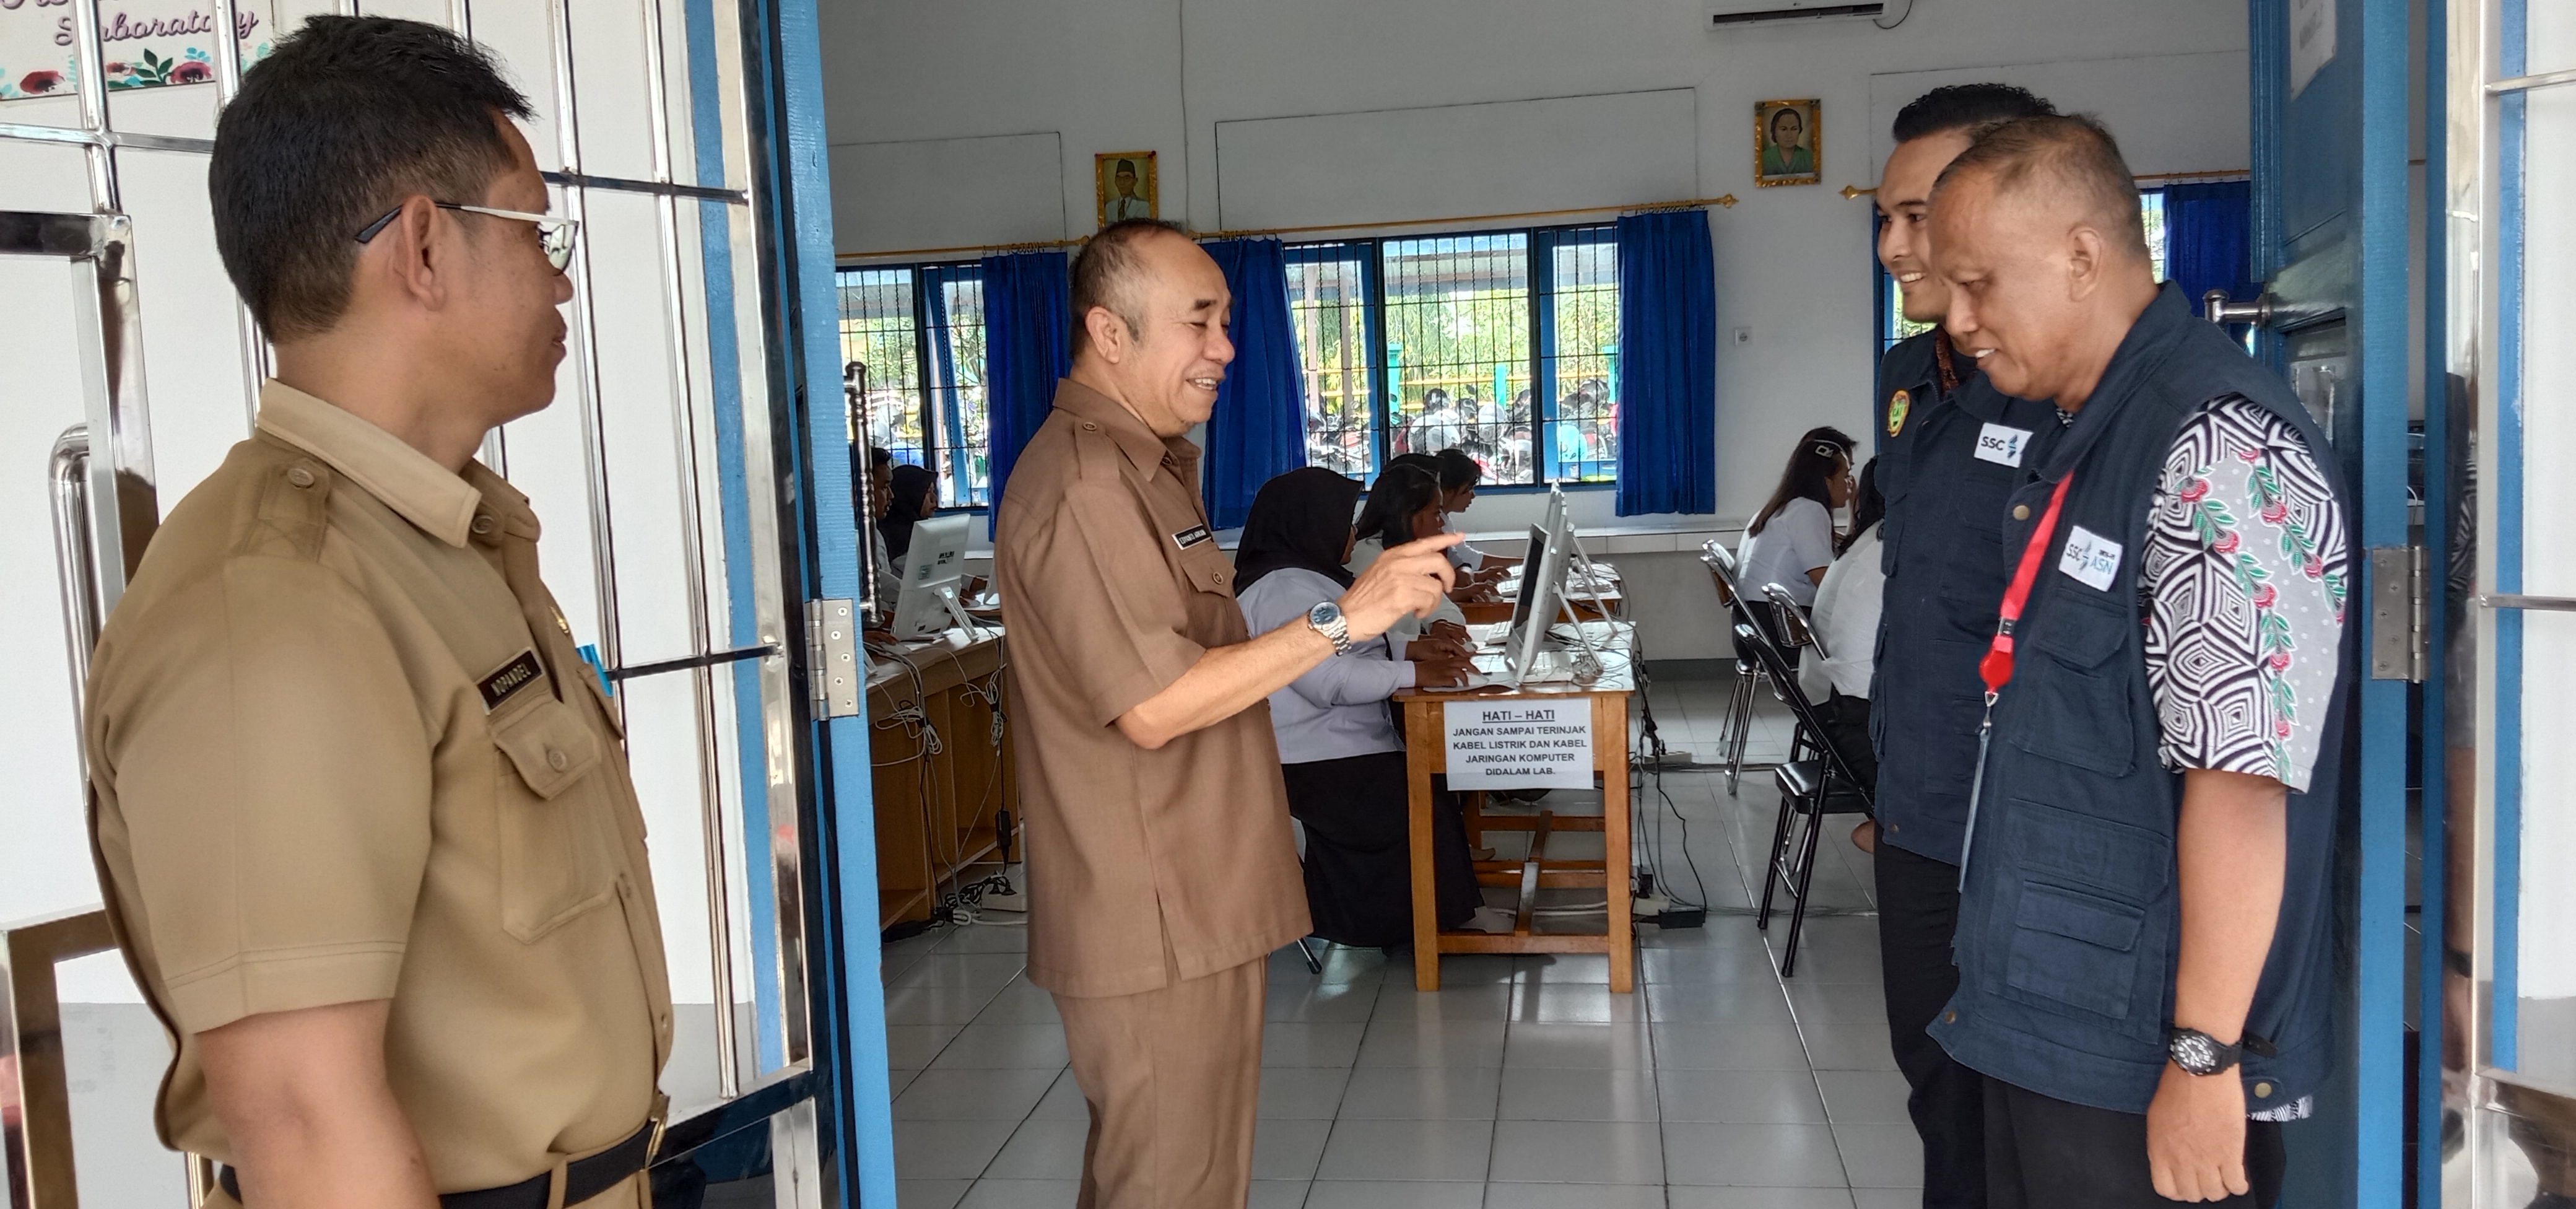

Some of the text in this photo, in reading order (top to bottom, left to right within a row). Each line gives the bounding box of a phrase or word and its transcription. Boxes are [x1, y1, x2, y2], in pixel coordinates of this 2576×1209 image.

[1980, 436, 2006, 451] SSC
[2066, 543, 2084, 562] SSC
[2089, 554, 2114, 575] ASN
[1482, 711, 1512, 721] HATI
[1525, 710, 1555, 720] HATI
[1453, 726, 1586, 736] JANGAN SAMPAI TERINJAK
[1489, 741, 1526, 749] LISTRIK
[1530, 740, 1550, 748] DAN
[1553, 740, 1587, 748] KABEL
[1466, 754, 1575, 763] JARINGAN KOMPUTER
